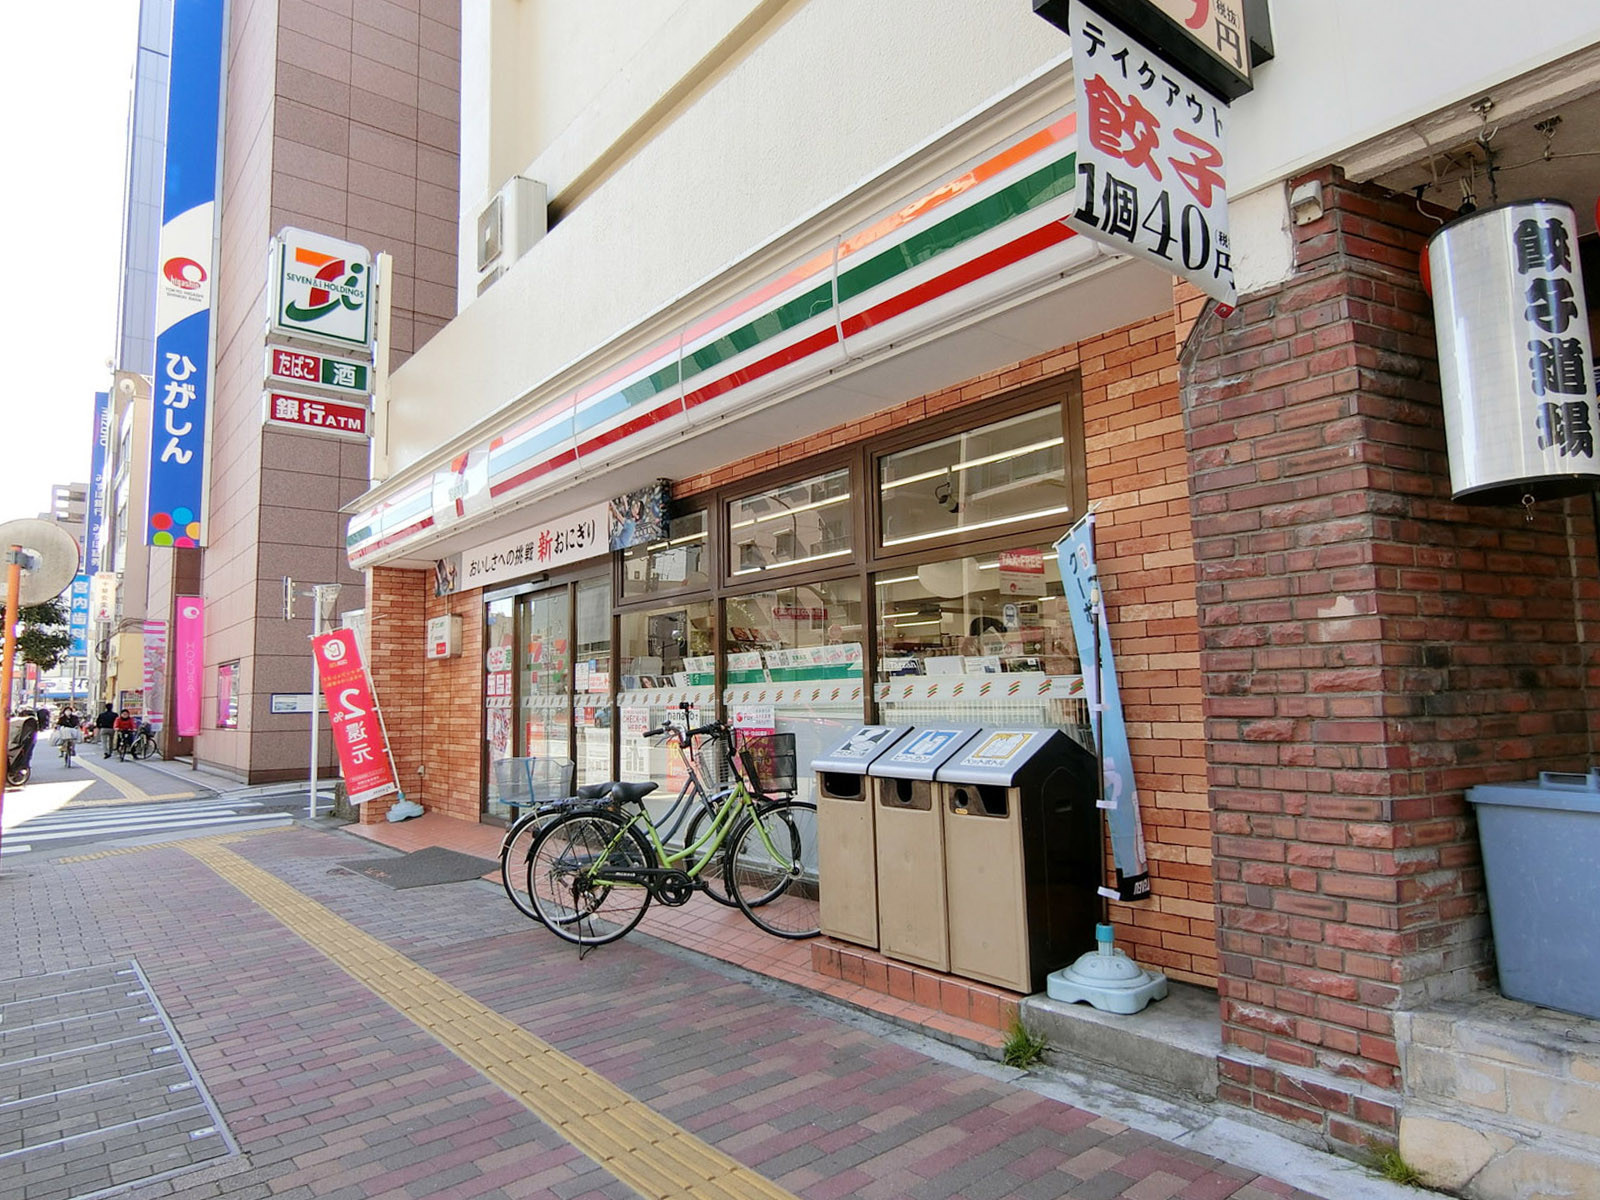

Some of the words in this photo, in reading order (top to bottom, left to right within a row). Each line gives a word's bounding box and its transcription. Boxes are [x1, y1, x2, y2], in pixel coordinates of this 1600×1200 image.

[1082, 20, 1223, 138] テイクアウト
[1083, 73, 1226, 209] 餃子
[323, 281, 364, 299] HOLDINGS
[278, 353, 315, 379] たばこ
[333, 362, 357, 387] 酒
[161, 352, 197, 464] ひがしん
[275, 398, 361, 430] 銀行ATM
[469, 541, 535, 577] おいしさへの挑戦
